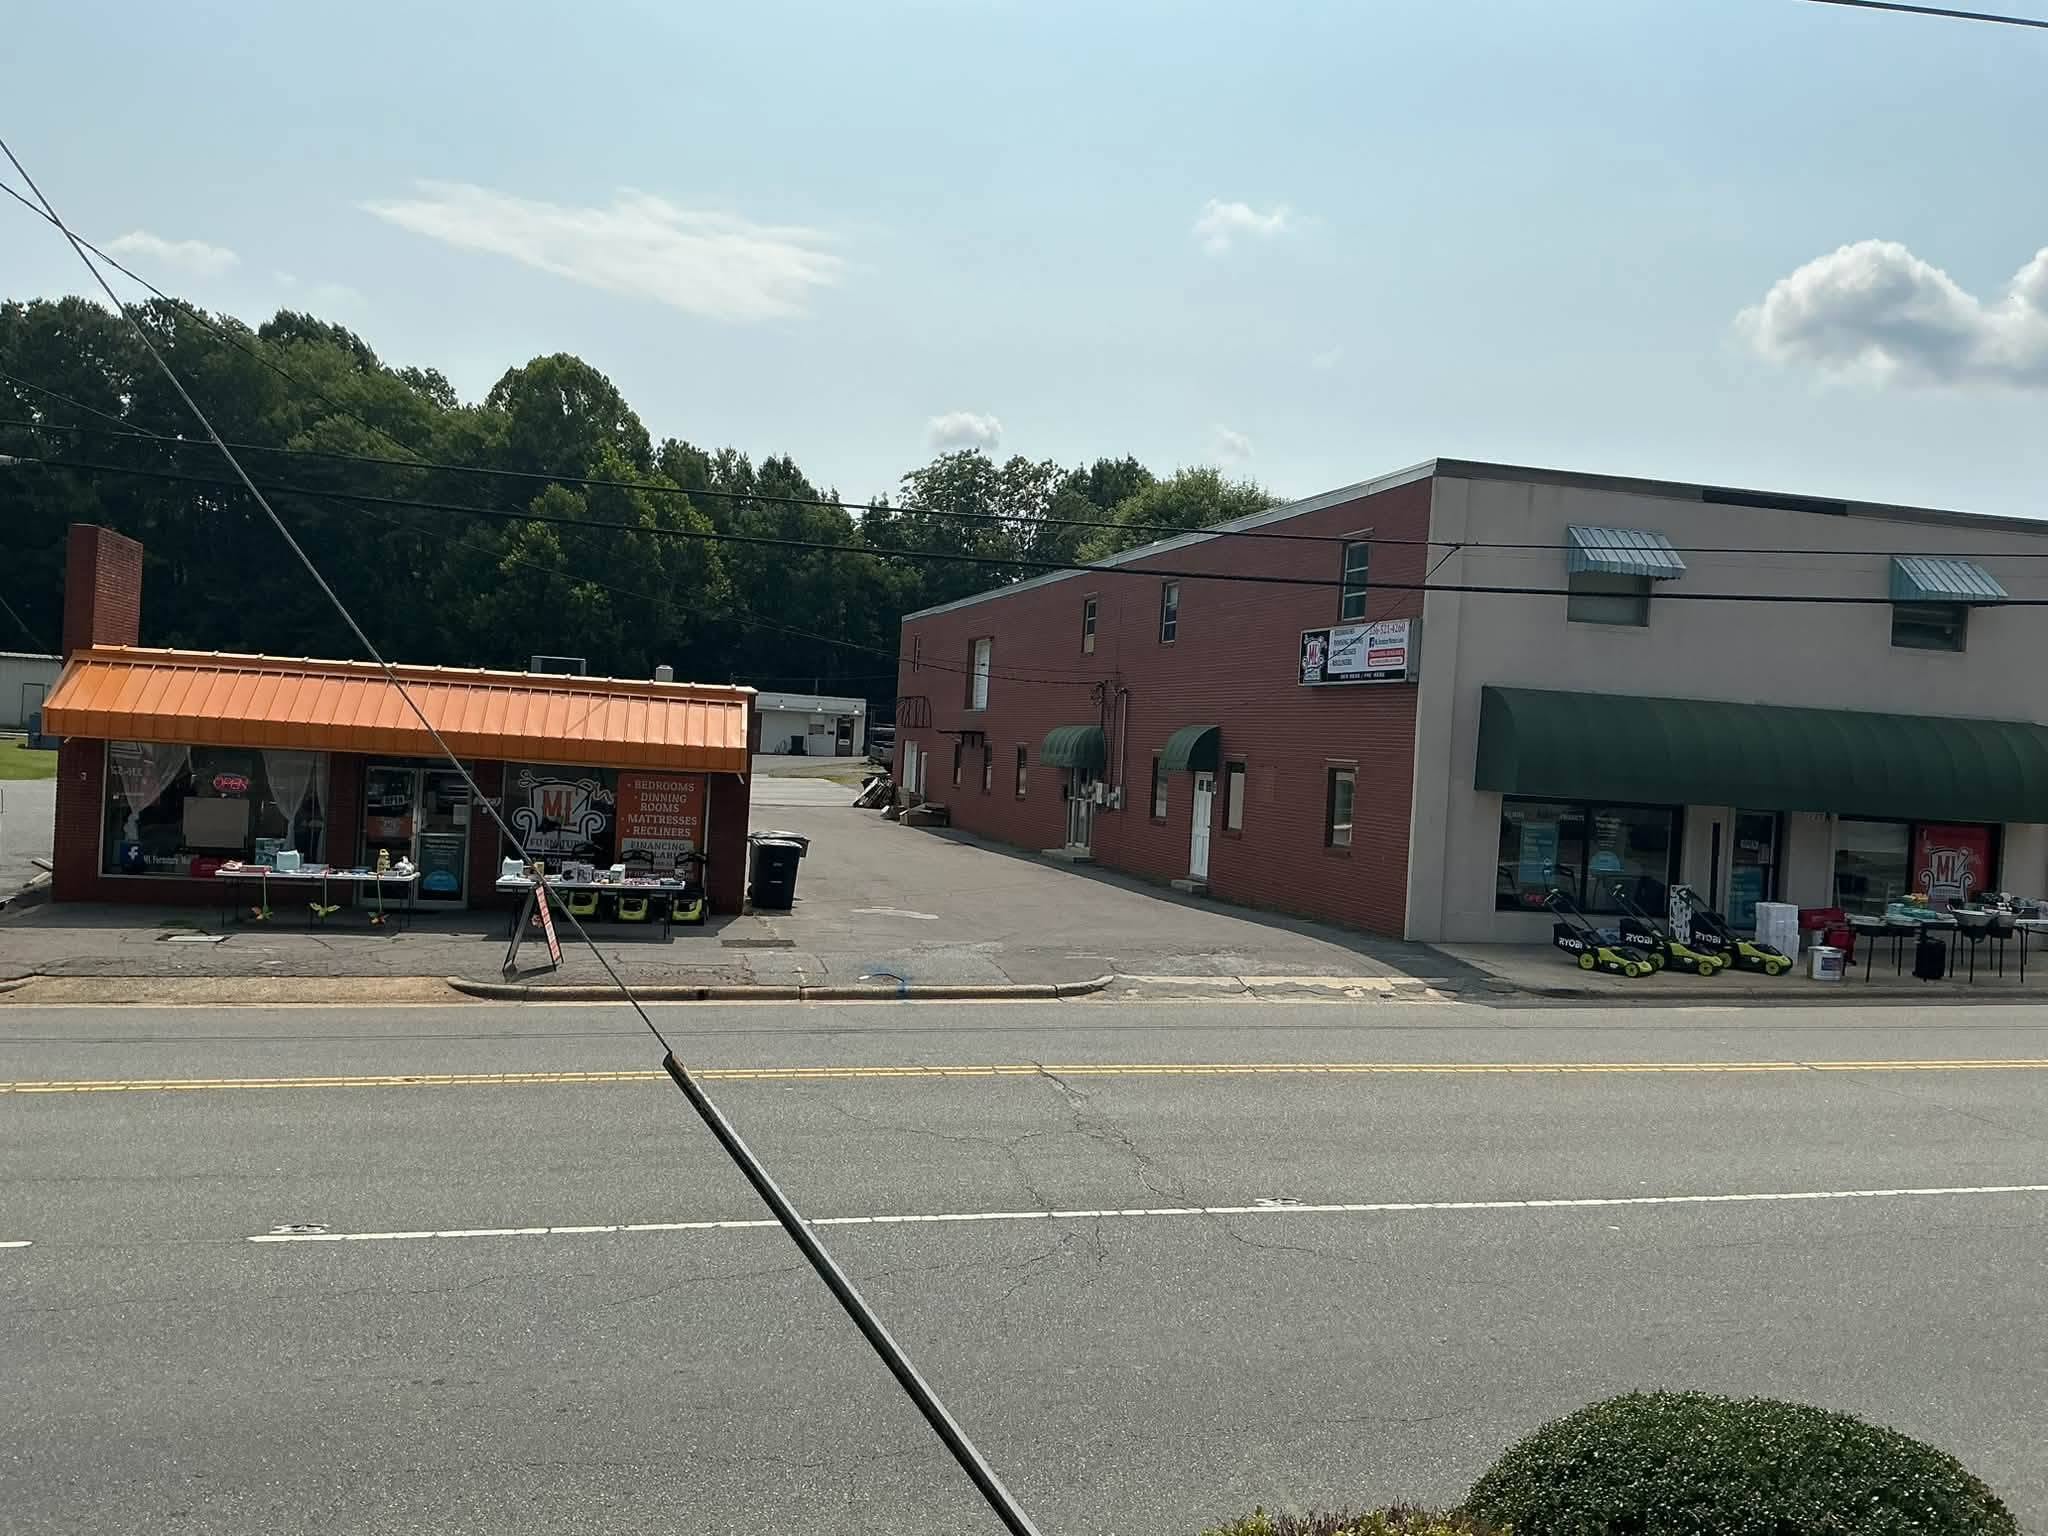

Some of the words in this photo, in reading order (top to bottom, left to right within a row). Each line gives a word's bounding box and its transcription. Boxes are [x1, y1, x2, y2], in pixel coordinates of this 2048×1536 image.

[213, 777, 249, 790] OPEN
[634, 780, 695, 792] BEDROOMS
[640, 792, 687, 803] DINNING
[640, 802, 680, 813] ROOMS
[628, 814, 697, 825] MATTRESSES
[633, 826, 691, 837] RECLINERS
[631, 840, 685, 850] FINANCING
[1559, 937, 1583, 949] RYOBI
[1626, 933, 1653, 945] RYOBI
[1695, 931, 1721, 944] RYOBI
